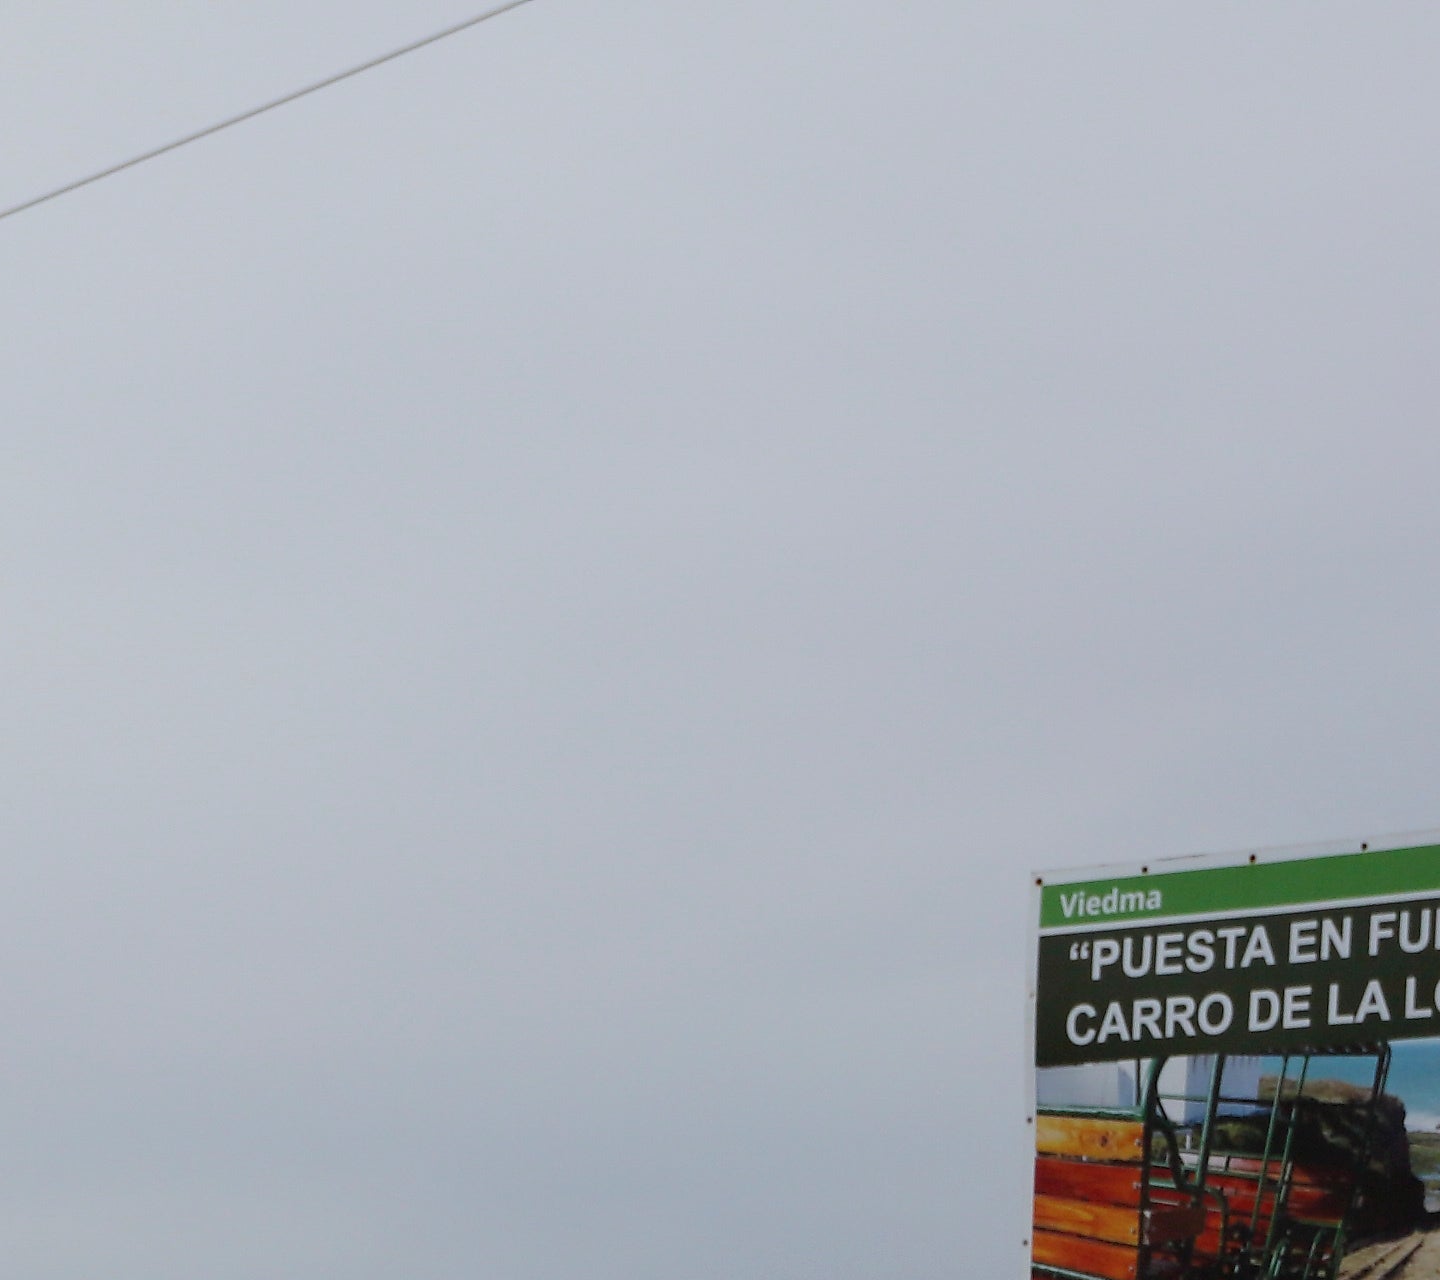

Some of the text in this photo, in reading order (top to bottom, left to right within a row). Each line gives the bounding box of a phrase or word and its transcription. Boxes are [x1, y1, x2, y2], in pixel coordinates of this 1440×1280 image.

[1060, 887, 1162, 919] Viedma
[1288, 916, 1352, 964] EN
[1065, 993, 1234, 1046] CARRO
[1248, 985, 1313, 1032] DE
[1327, 979, 1391, 1026] LA
